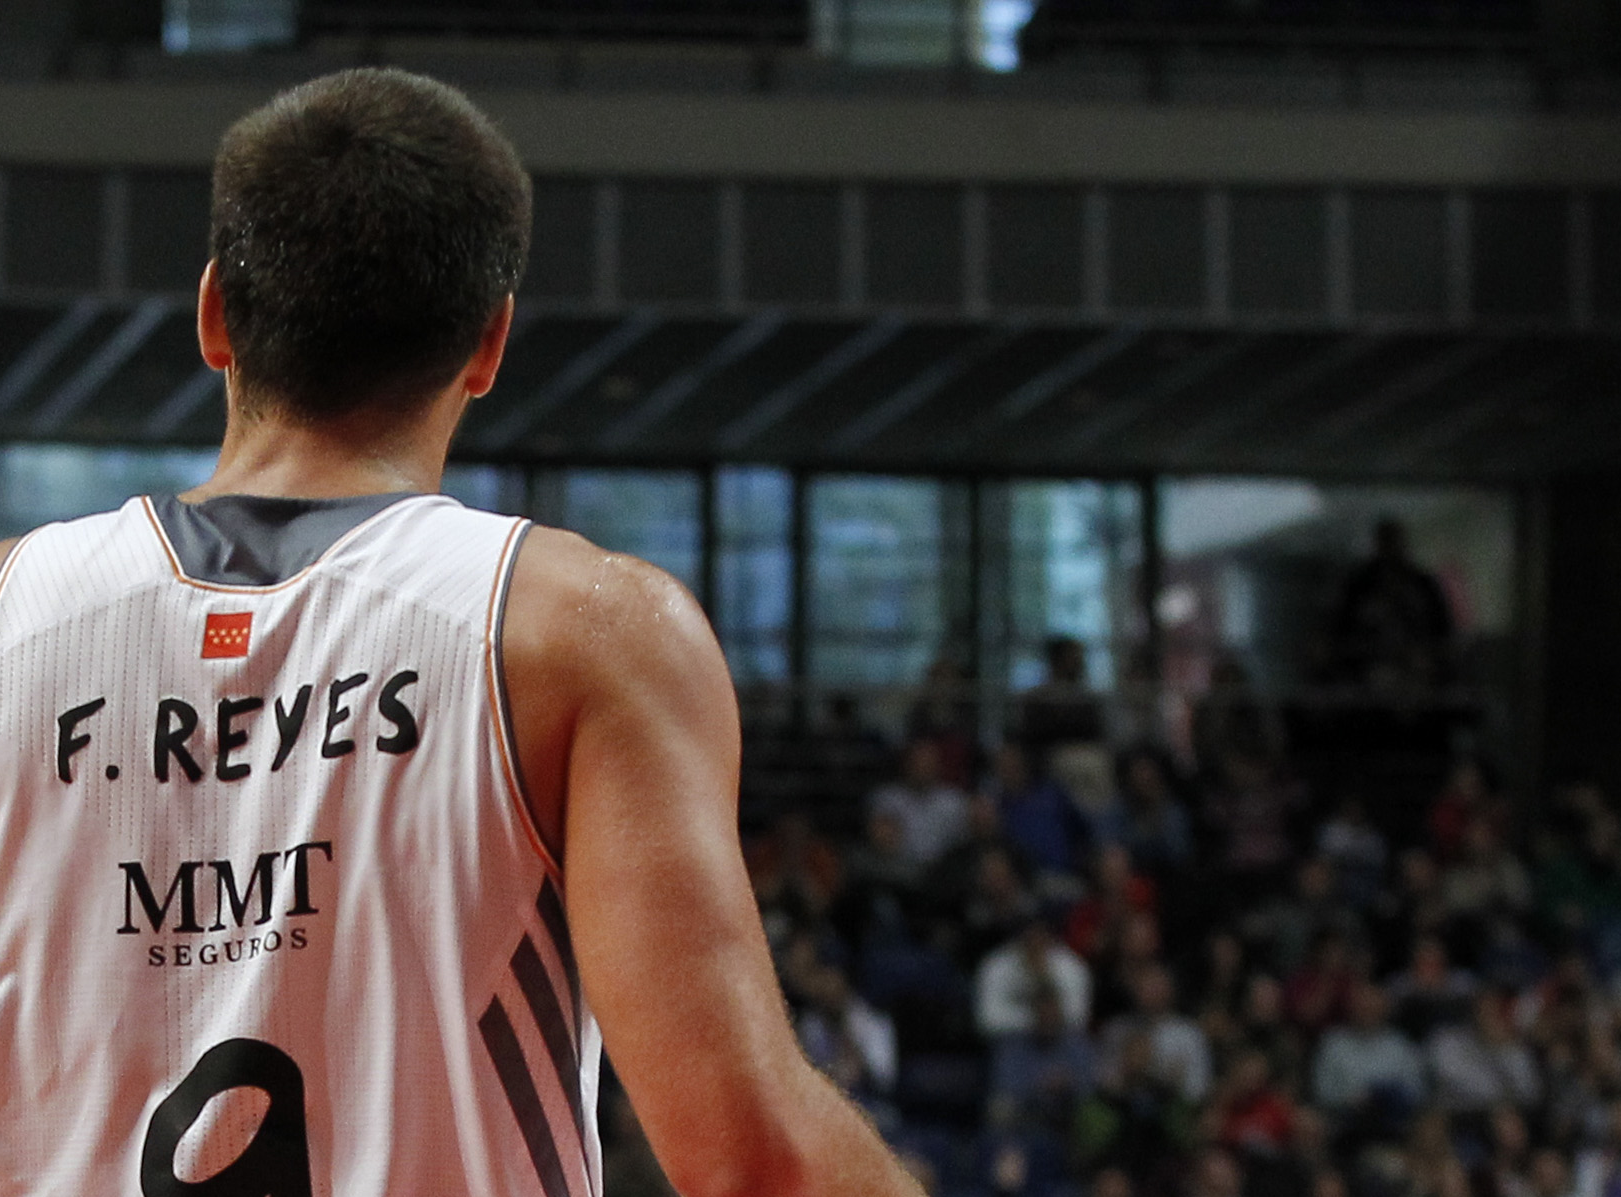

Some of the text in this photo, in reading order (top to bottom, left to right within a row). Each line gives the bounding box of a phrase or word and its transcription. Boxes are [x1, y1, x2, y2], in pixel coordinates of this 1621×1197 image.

[56, 670, 420, 784] F. REYES
[116, 841, 332, 934] MMT
[148, 927, 308, 967] SEGUROS
